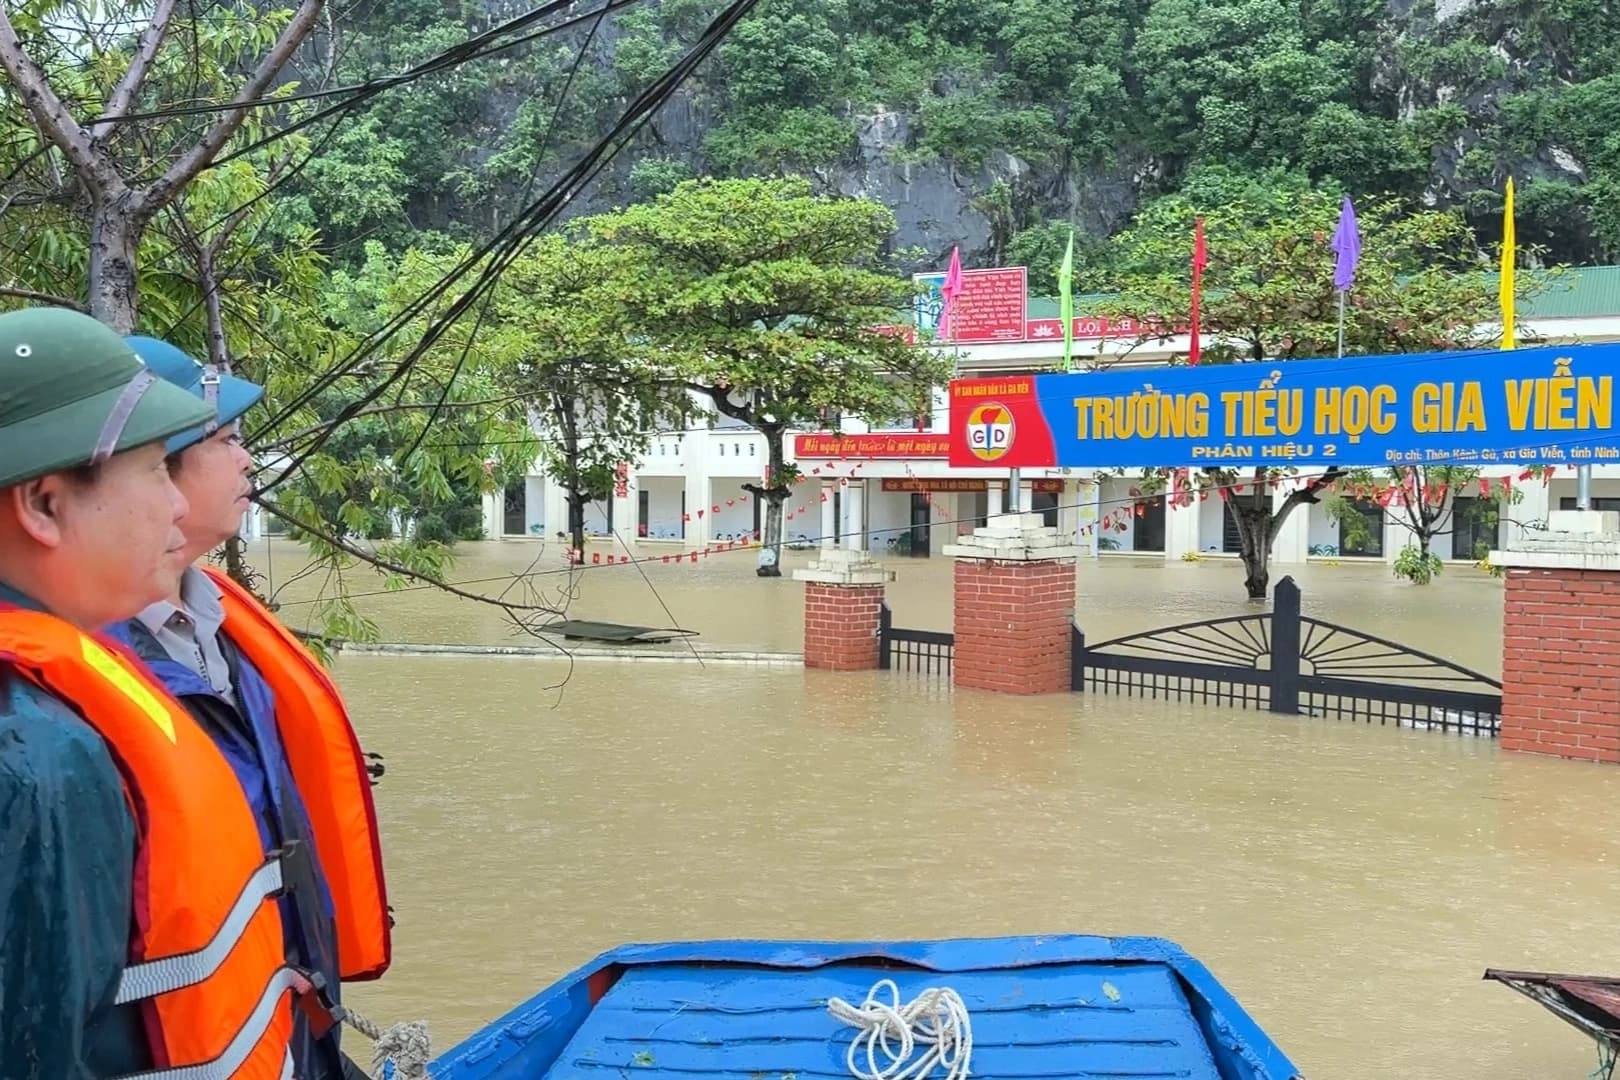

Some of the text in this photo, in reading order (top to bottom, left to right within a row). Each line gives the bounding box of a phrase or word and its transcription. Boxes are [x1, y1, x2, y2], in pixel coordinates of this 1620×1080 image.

[1073, 357, 1613, 444] TRƯỜNG TIỂU HỌC GIA VIỄN
[820, 438, 840, 454] ngày
[915, 438, 937, 454] ngày
[1191, 442, 1337, 460] PHÂN HIỆU 2
[1386, 448, 1402, 461] Địa
[1519, 448, 1537, 460] Gia
[1594, 446, 1619, 459] Ninh
